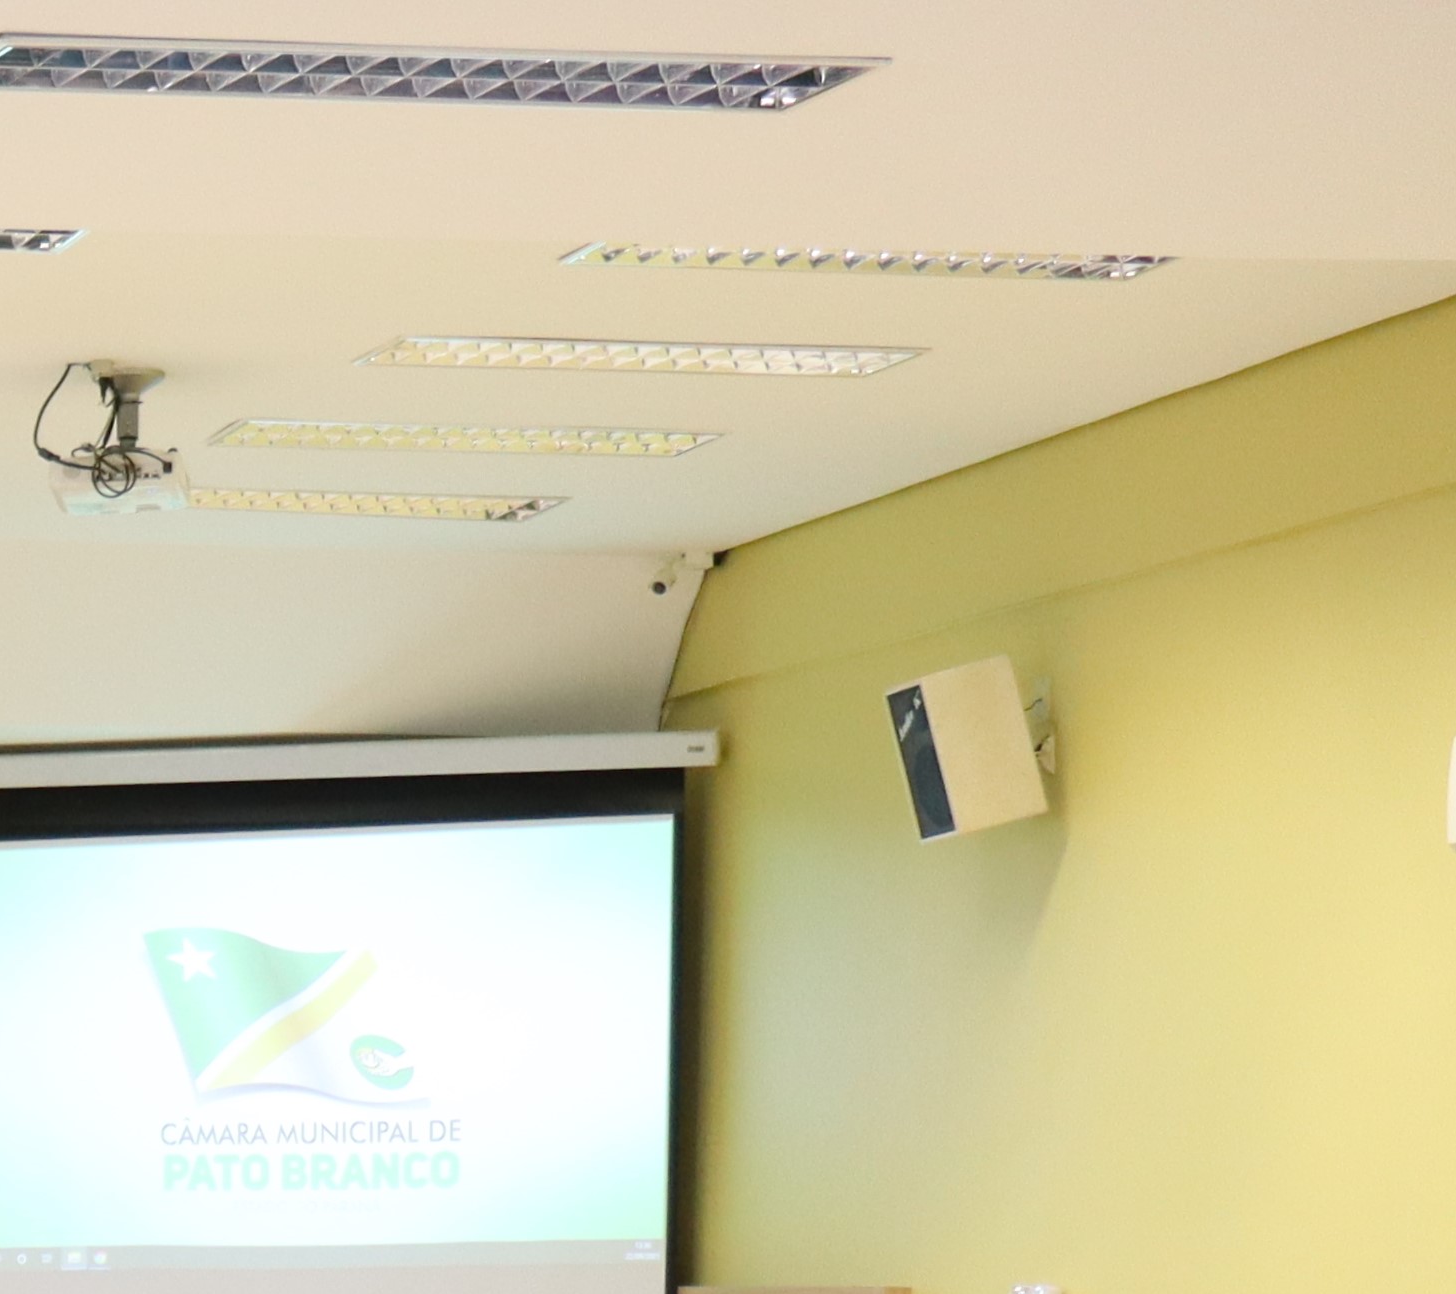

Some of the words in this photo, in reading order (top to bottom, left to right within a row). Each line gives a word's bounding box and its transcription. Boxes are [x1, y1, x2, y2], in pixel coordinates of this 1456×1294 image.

[160, 1117, 268, 1146] CÂMARA
[277, 1120, 419, 1145] MUNICIPAL
[429, 1119, 462, 1143] DE
[162, 1152, 270, 1191] PATO
[282, 1150, 461, 1191] BRANCO
